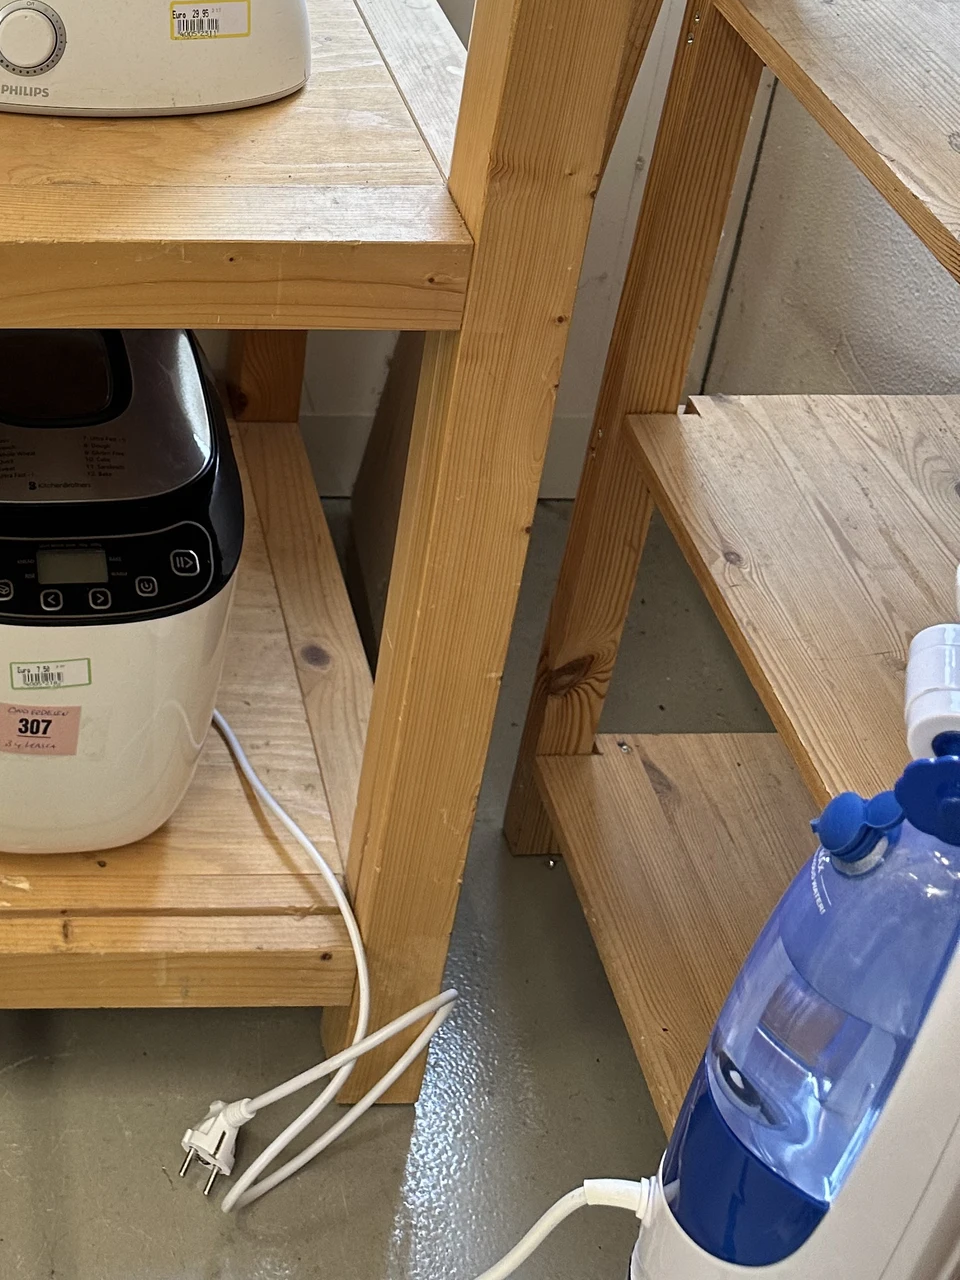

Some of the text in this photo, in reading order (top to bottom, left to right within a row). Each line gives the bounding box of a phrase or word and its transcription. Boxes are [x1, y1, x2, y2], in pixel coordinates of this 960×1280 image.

[172, 10, 187, 19] Euro
[1, 84, 50, 98] PHILIPS
[18, 718, 52, 735] 307
